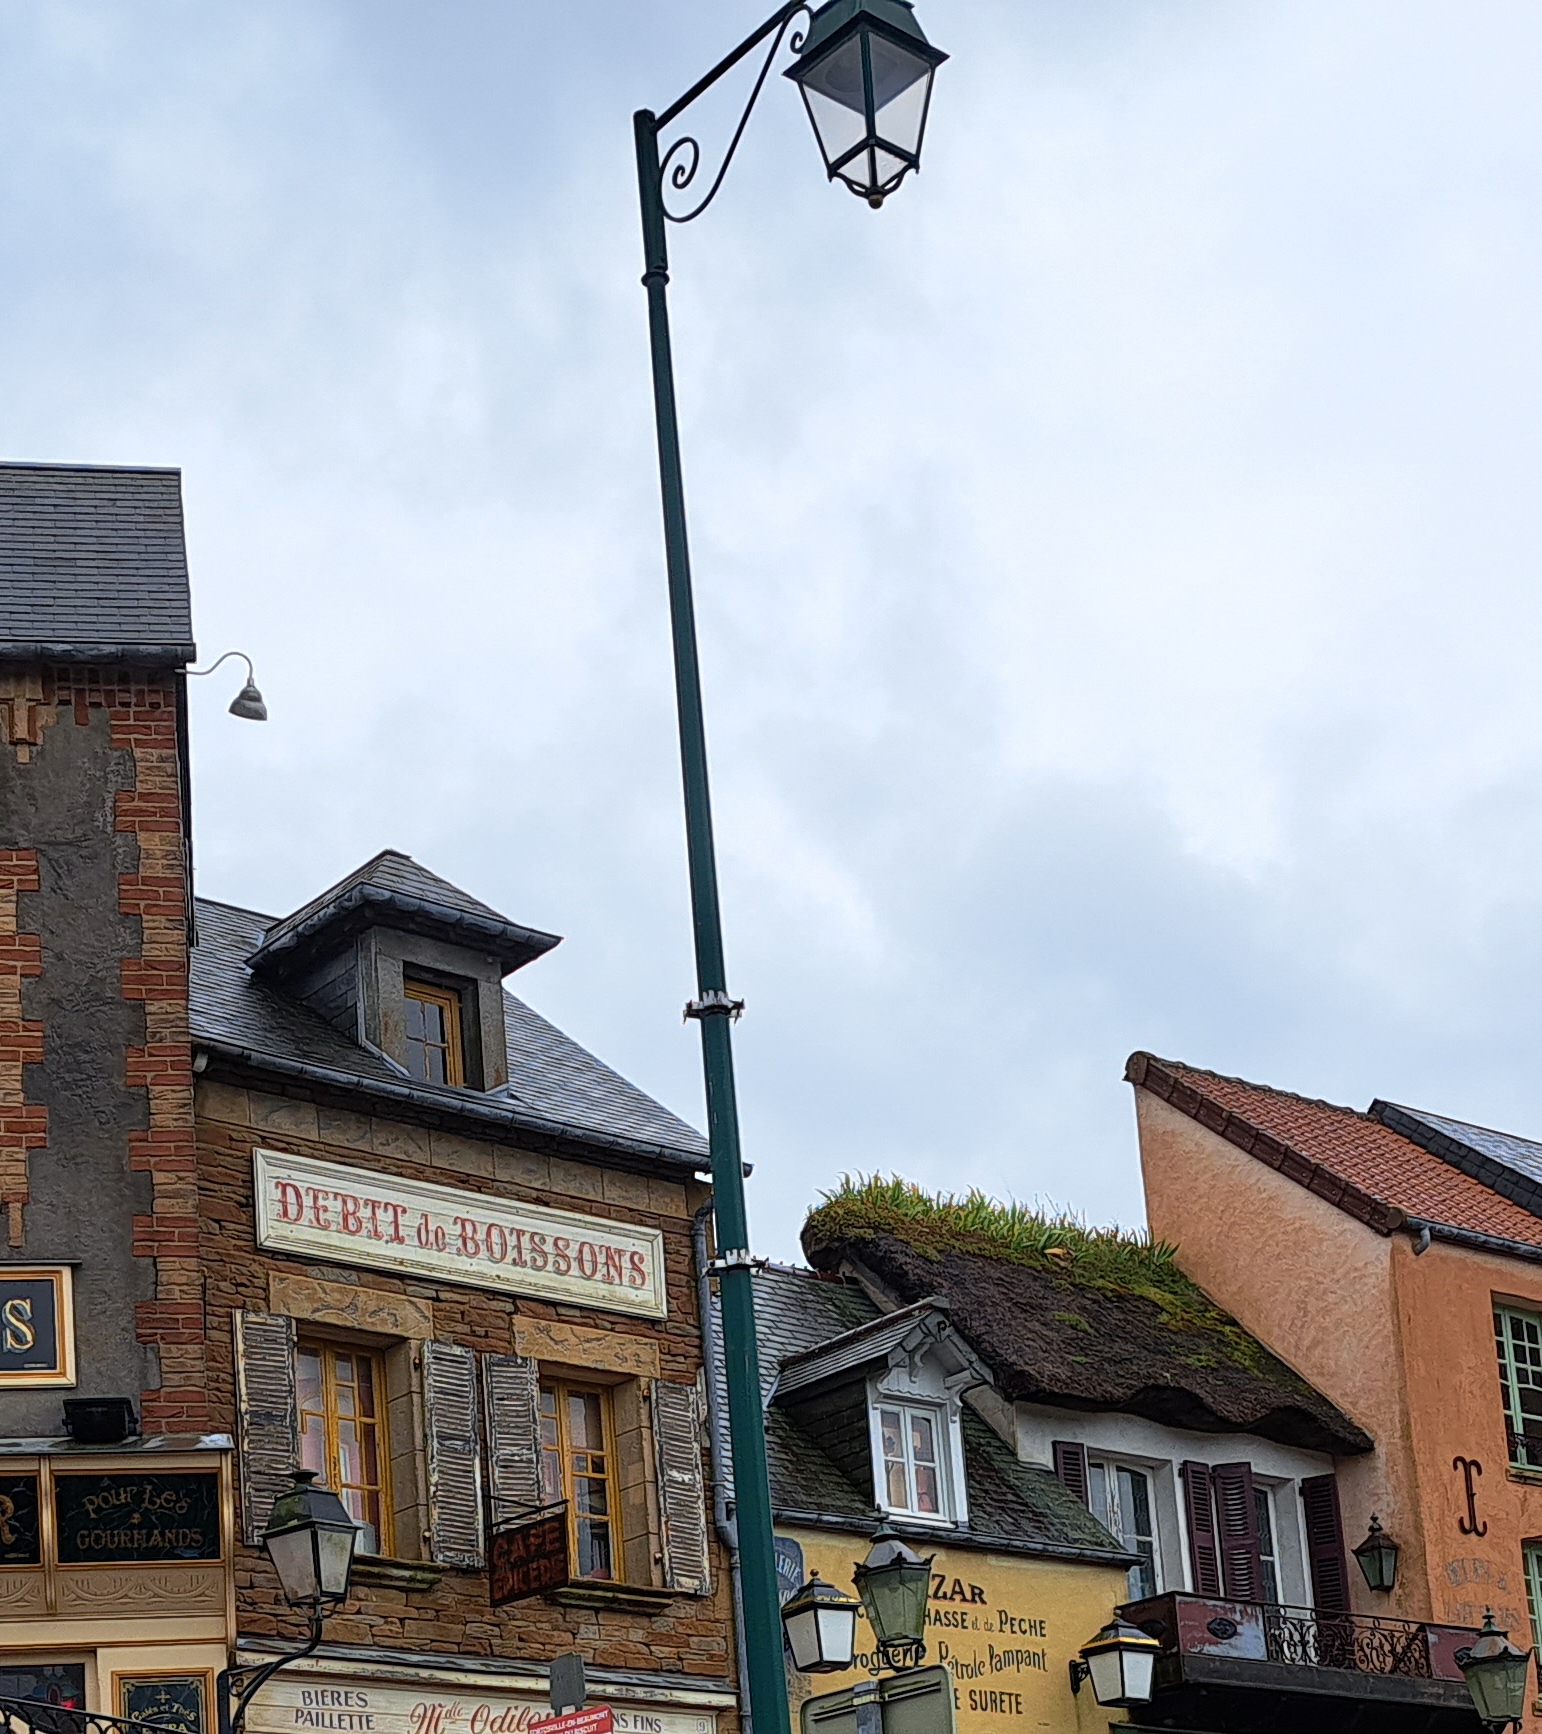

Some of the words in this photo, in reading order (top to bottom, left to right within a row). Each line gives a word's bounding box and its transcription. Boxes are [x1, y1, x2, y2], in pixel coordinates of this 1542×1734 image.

[274, 1180, 407, 1245] DEBIT
[416, 1212, 447, 1252] de
[453, 1216, 649, 1289] BOISSONS
[76, 1528, 204, 1550] GOURMANDS
[774, 1551, 802, 1583] LERIE
[928, 1573, 988, 1606] ZAR
[923, 1608, 969, 1629] HASSE
[969, 1688, 1024, 1715] SURETE
[294, 1708, 376, 1731] PAILLETTE
[633, 1714, 662, 1734] FINS
